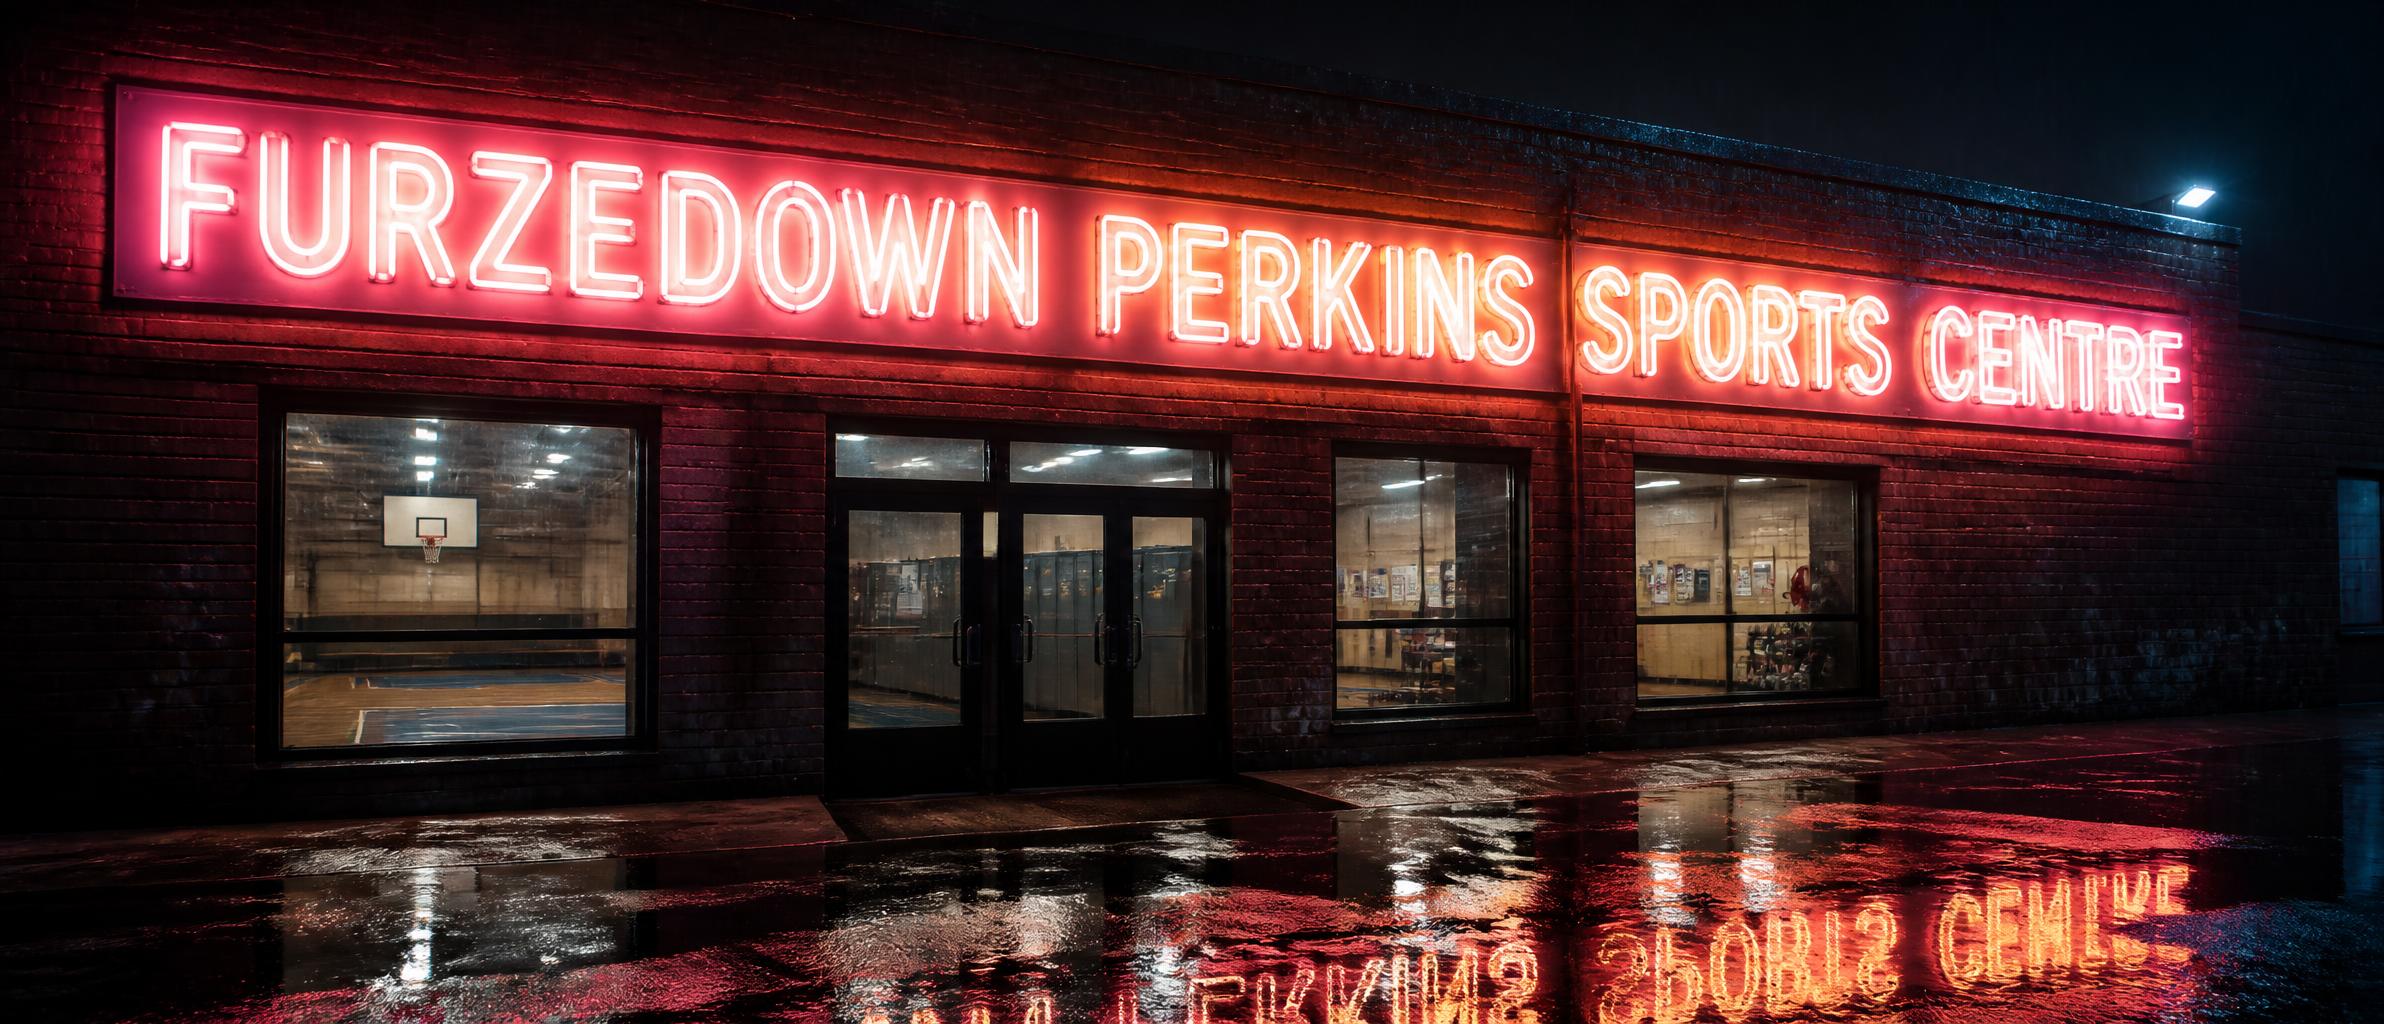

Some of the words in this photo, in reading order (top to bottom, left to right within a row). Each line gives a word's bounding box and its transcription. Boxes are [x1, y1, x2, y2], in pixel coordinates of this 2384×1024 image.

[159, 121, 1041, 329] FURZEDOWN
[1096, 213, 1537, 367] PERKINS
[1579, 265, 1893, 397] SPORTS
[1925, 304, 2186, 421] CENTRE
